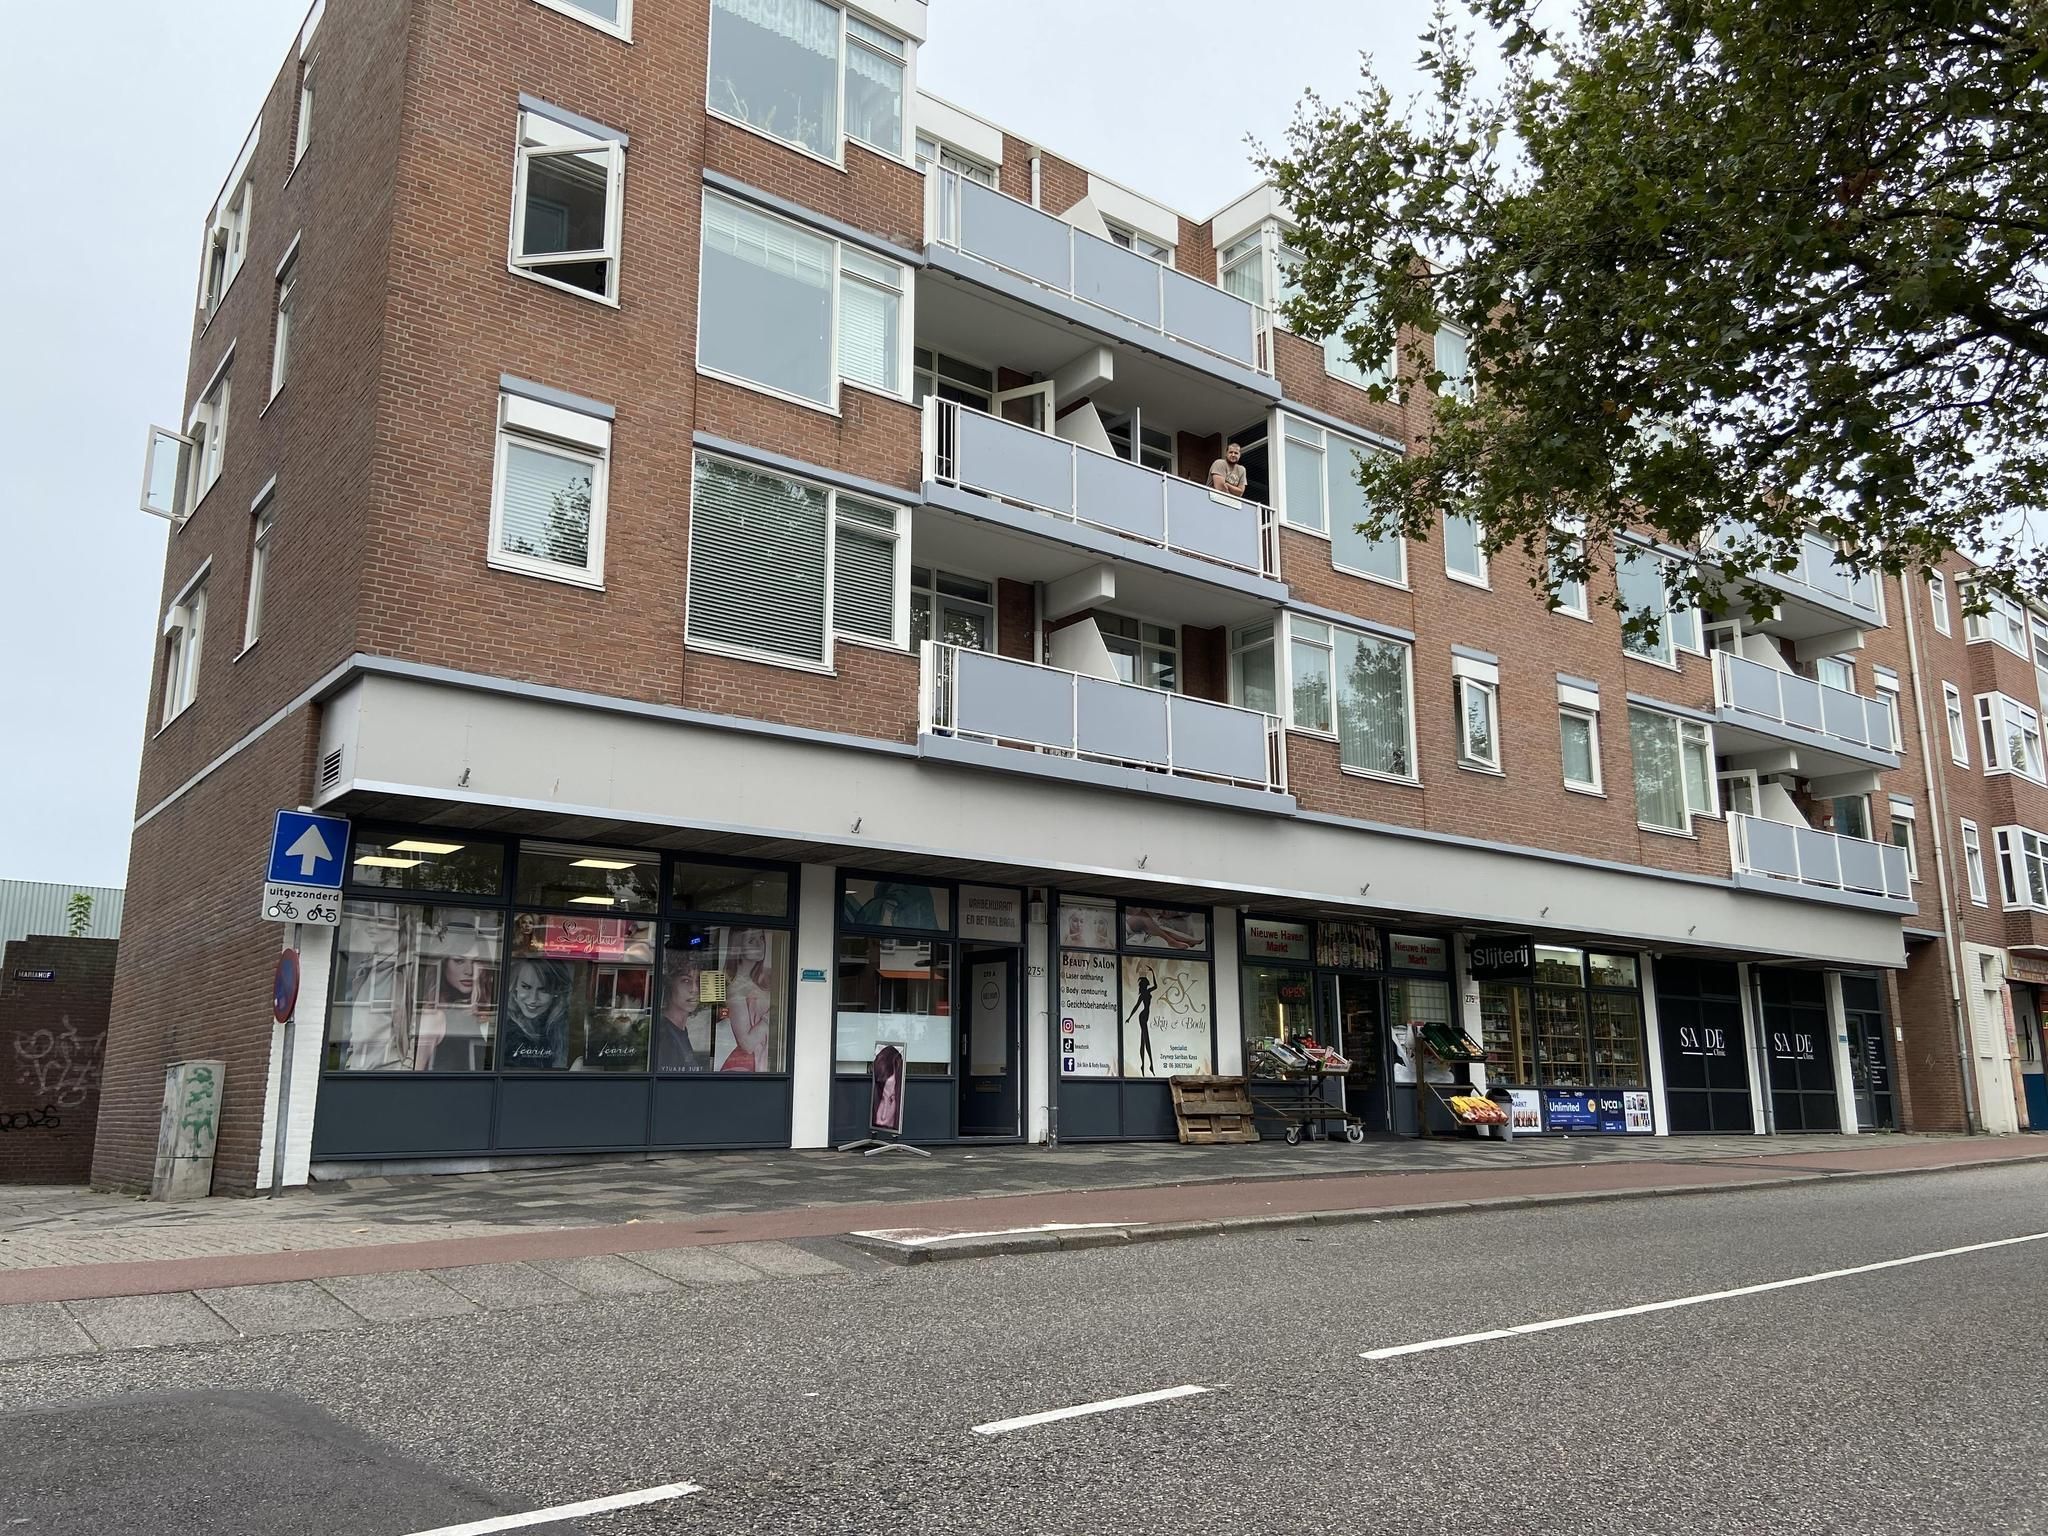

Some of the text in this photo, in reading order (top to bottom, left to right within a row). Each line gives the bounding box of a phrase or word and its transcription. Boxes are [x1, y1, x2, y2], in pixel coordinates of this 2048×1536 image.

[269, 888, 339, 901] uitgezonderd
[1250, 927, 1304, 942] Nieuwe Haven
[1266, 942, 1288, 953] Markt
[1394, 941, 1441, 955] Nieuwe Haven
[1408, 954, 1428, 965] Markt
[1473, 944, 1529, 969] Slijterij
[1066, 986, 1079, 995] Body
[1281, 985, 1305, 999] OPEN
[1549, 1101, 1580, 1113] Unlimited
[1600, 1098, 1618, 1112] Lyca
